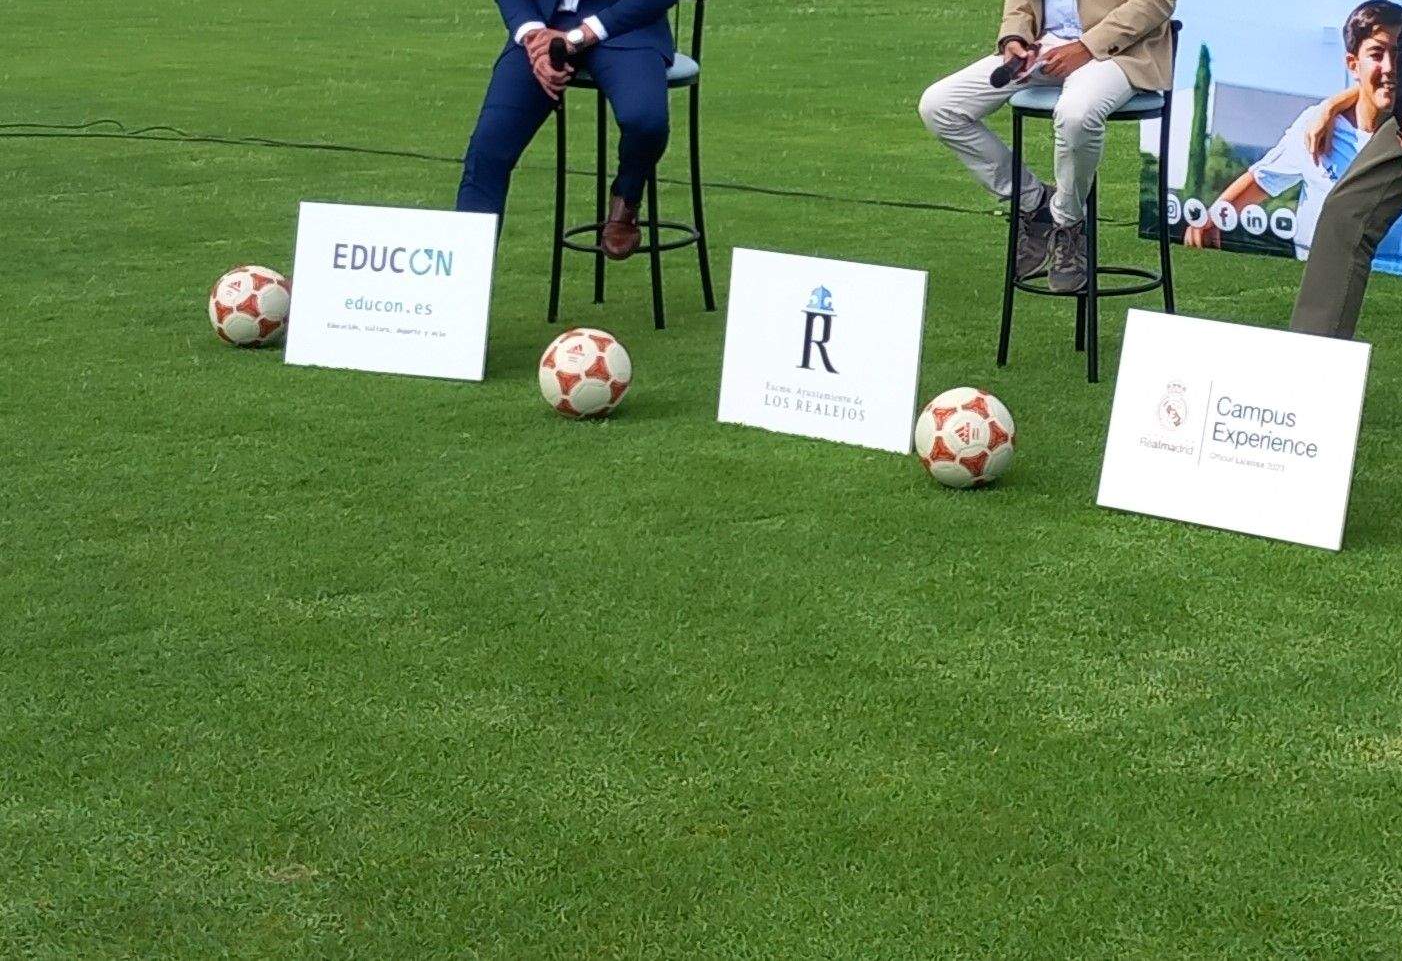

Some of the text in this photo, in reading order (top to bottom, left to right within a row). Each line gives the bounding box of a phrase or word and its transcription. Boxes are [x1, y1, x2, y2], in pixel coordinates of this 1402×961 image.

[333, 243, 453, 276] EDUCON
[345, 296, 433, 315] educon.es
[764, 393, 866, 422] LOS REALEJOS
[1216, 396, 1297, 428] Campus
[1212, 421, 1319, 459] Experience
